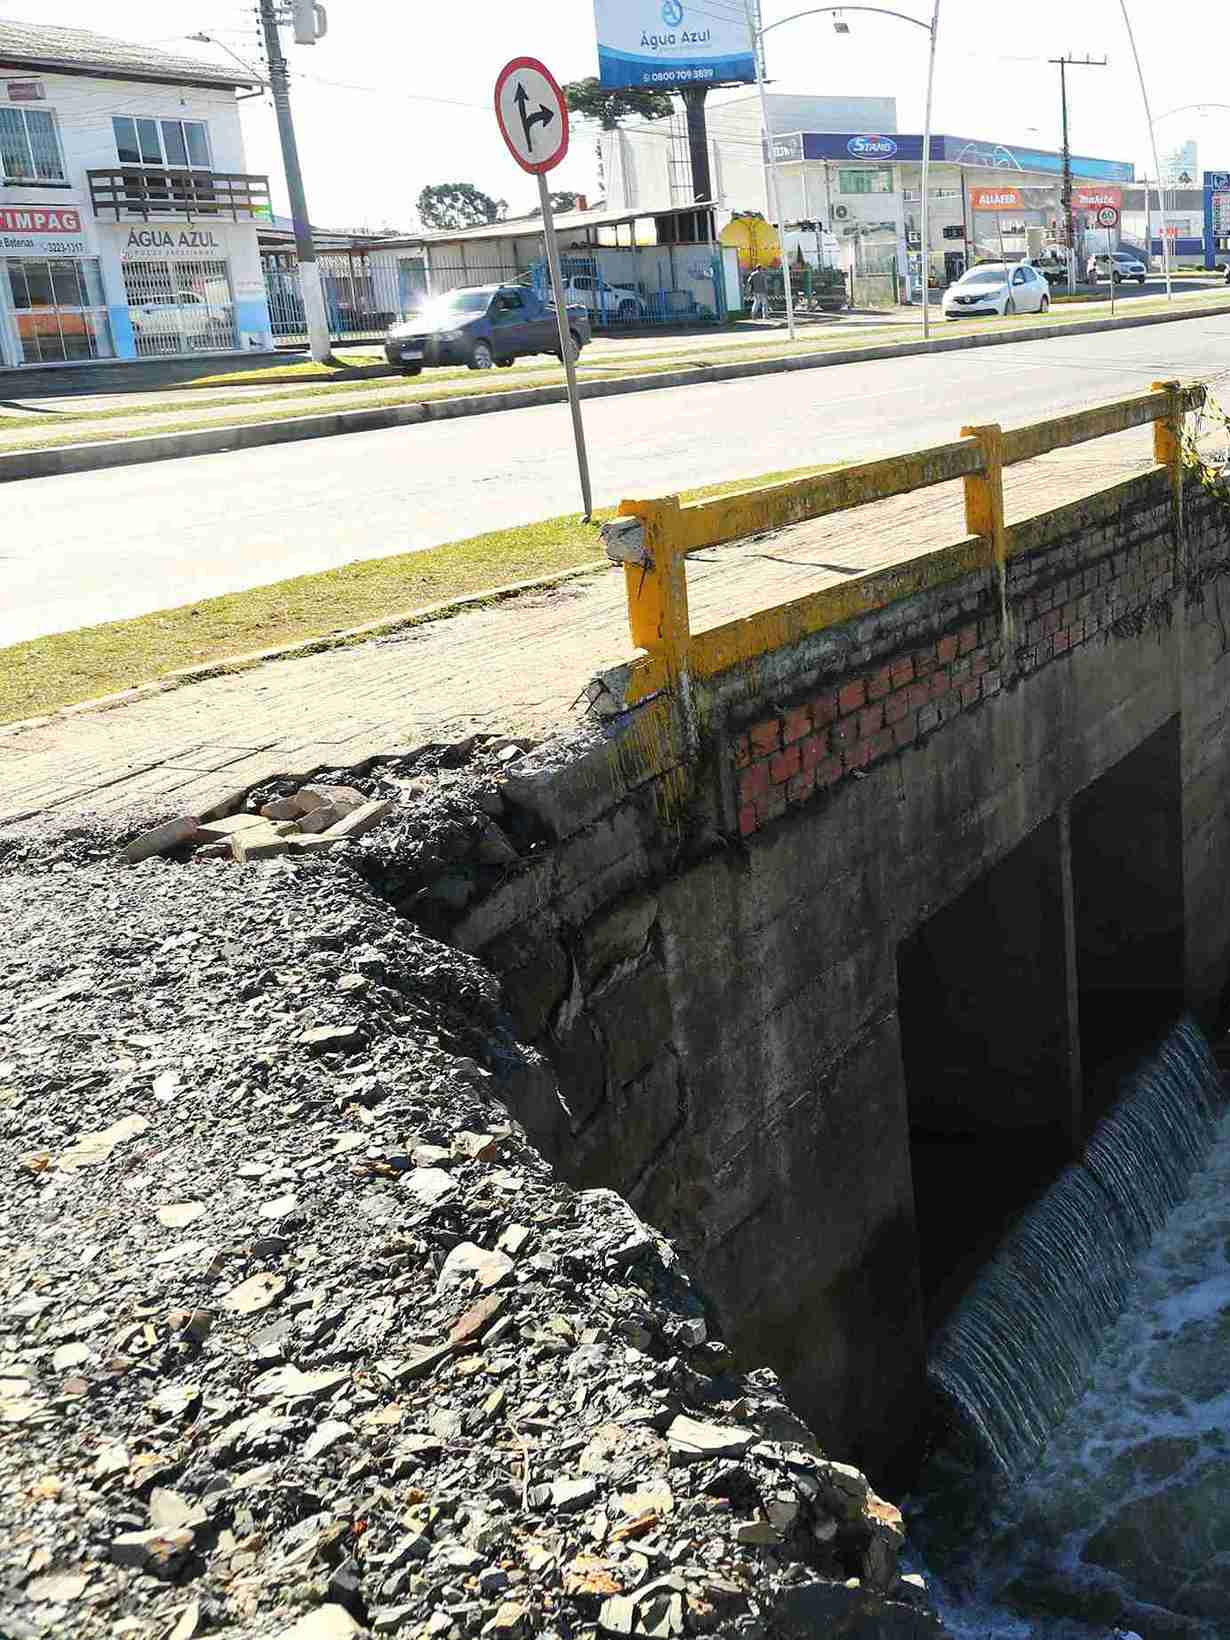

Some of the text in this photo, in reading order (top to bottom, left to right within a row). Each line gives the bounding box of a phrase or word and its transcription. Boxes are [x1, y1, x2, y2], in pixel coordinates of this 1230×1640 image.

[641, 29, 711, 50] Água Azul
[652, 72, 675, 82] 0800
[128, 227, 219, 247] ÁGUA AZUL
